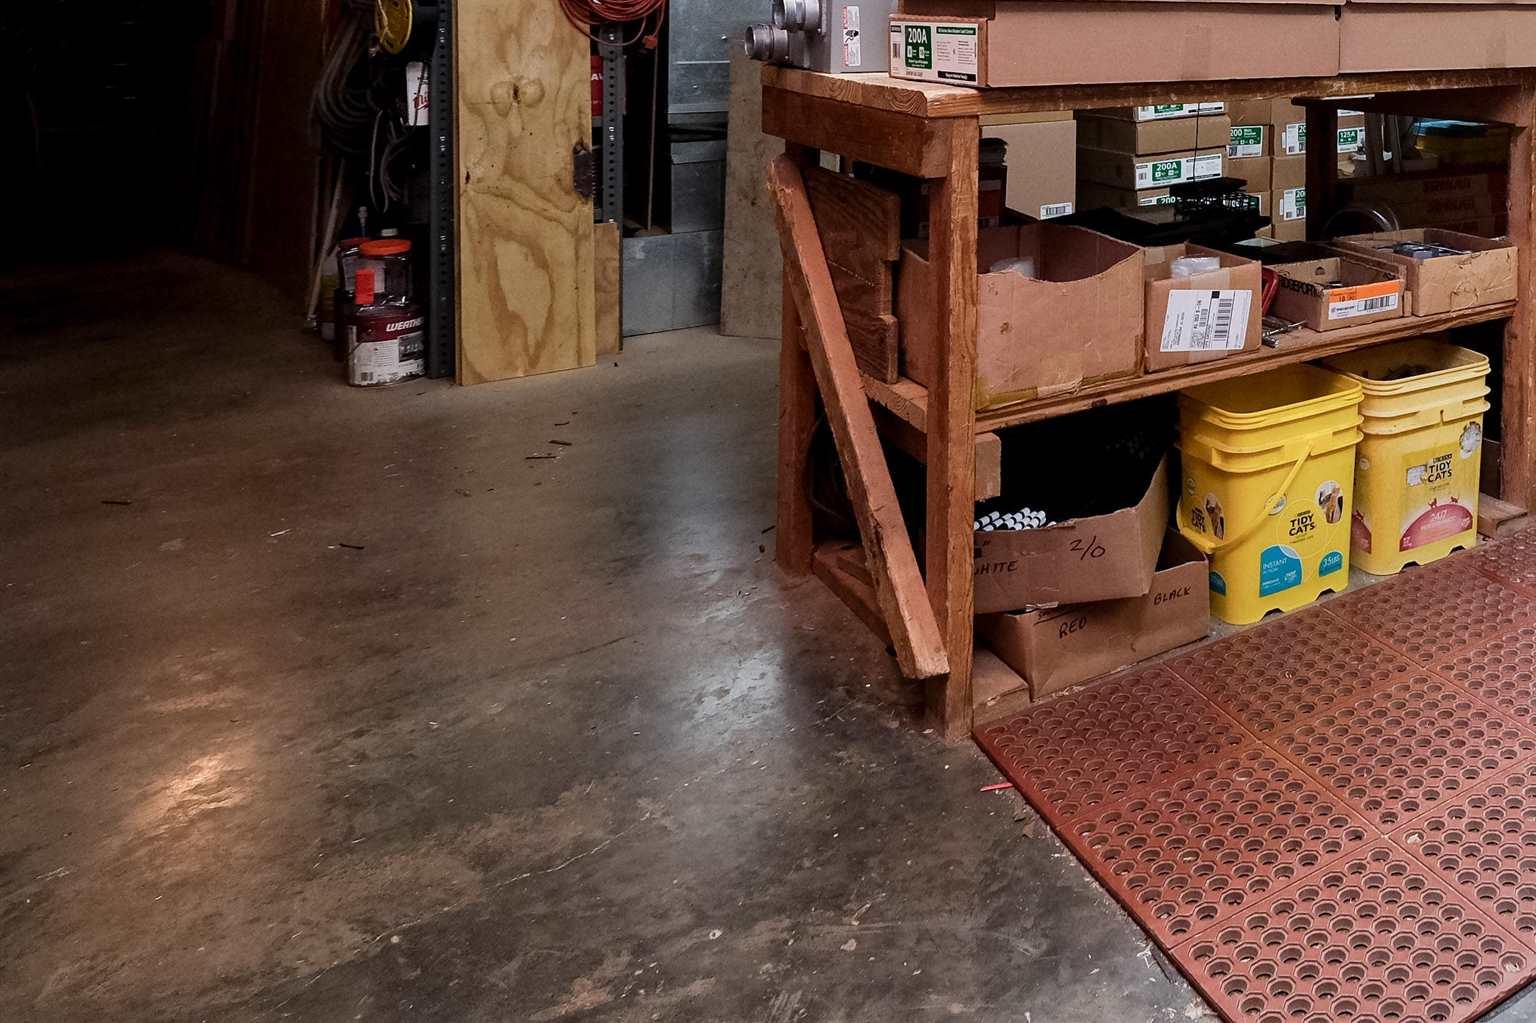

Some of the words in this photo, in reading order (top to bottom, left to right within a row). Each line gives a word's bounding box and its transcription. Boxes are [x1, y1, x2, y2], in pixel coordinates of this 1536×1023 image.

[908, 28, 927, 44] 200A
[1156, 162, 1178, 171] 200A
[1429, 460, 1452, 473] TIDY
[1427, 469, 1453, 483] CATS
[1290, 513, 1315, 527] TIDY
[1288, 522, 1316, 537] CATS
[1069, 535, 1107, 561] 2/0
[1153, 585, 1192, 606] BLACK
[1058, 615, 1088, 639] RED
